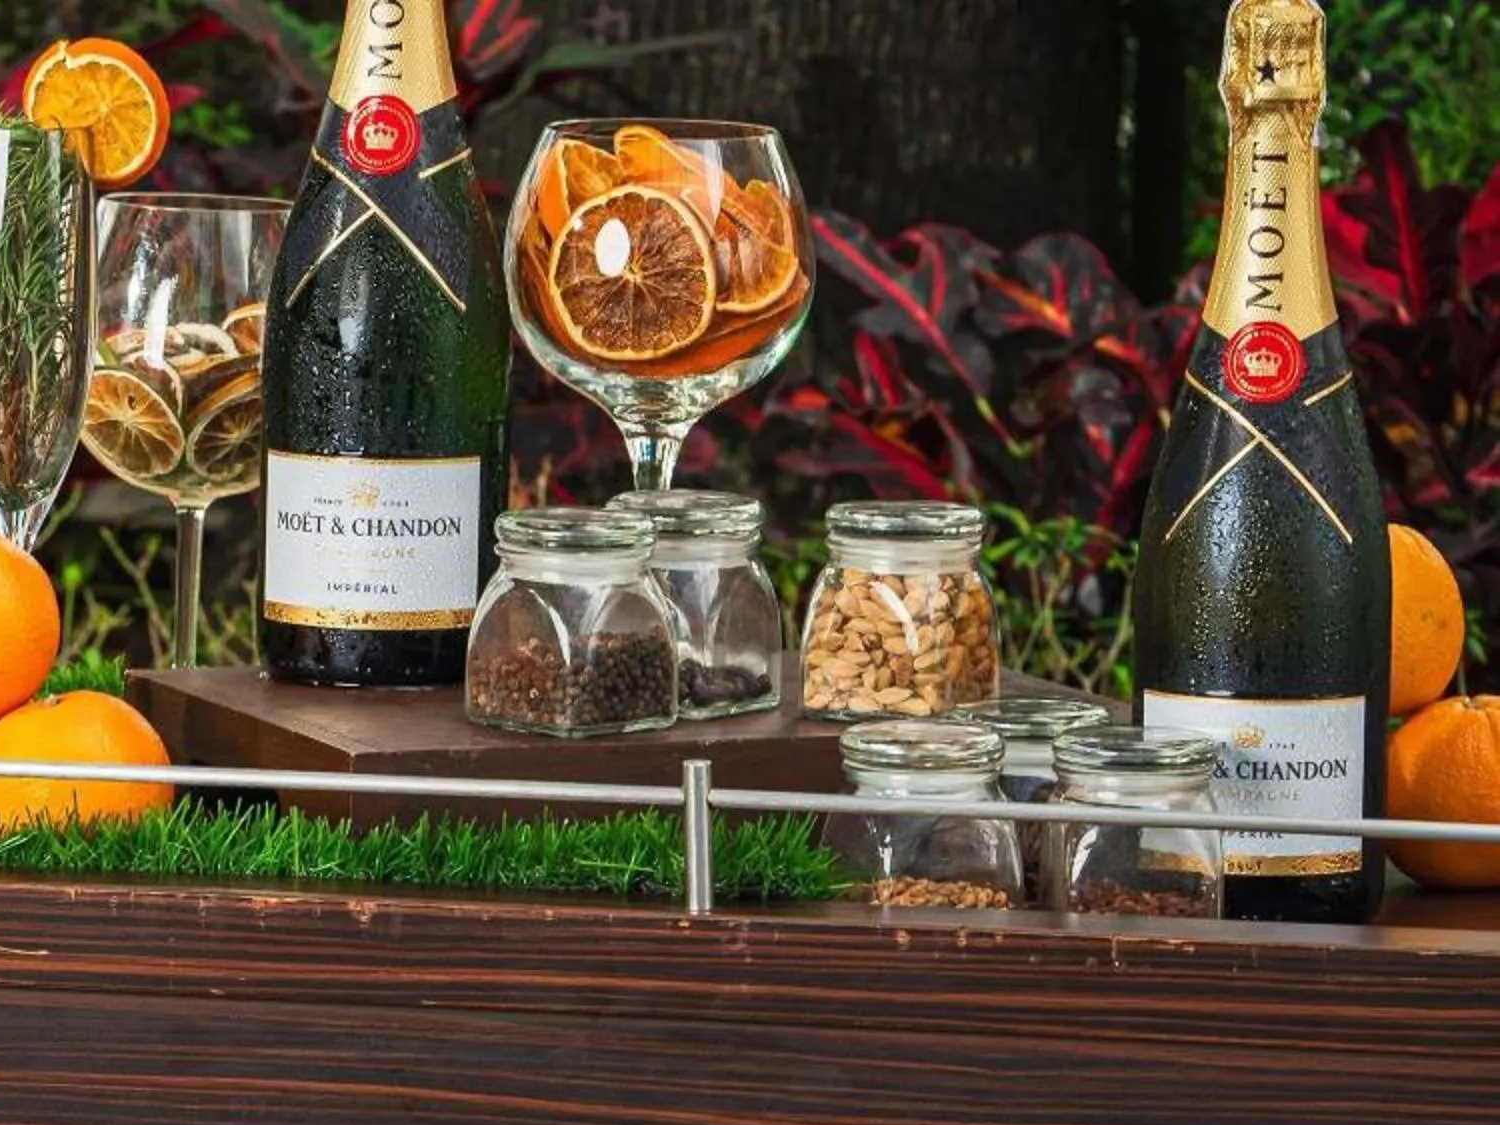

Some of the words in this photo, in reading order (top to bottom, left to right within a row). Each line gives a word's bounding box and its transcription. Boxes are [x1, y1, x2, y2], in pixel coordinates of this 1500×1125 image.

[1244, 142, 1289, 313] MOËT
[277, 511, 326, 534] MOËT
[331, 517, 346, 536] &
[352, 516, 462, 537] CHANDON
[1213, 760, 1229, 779] &
[1236, 759, 1348, 781] CHANDON
